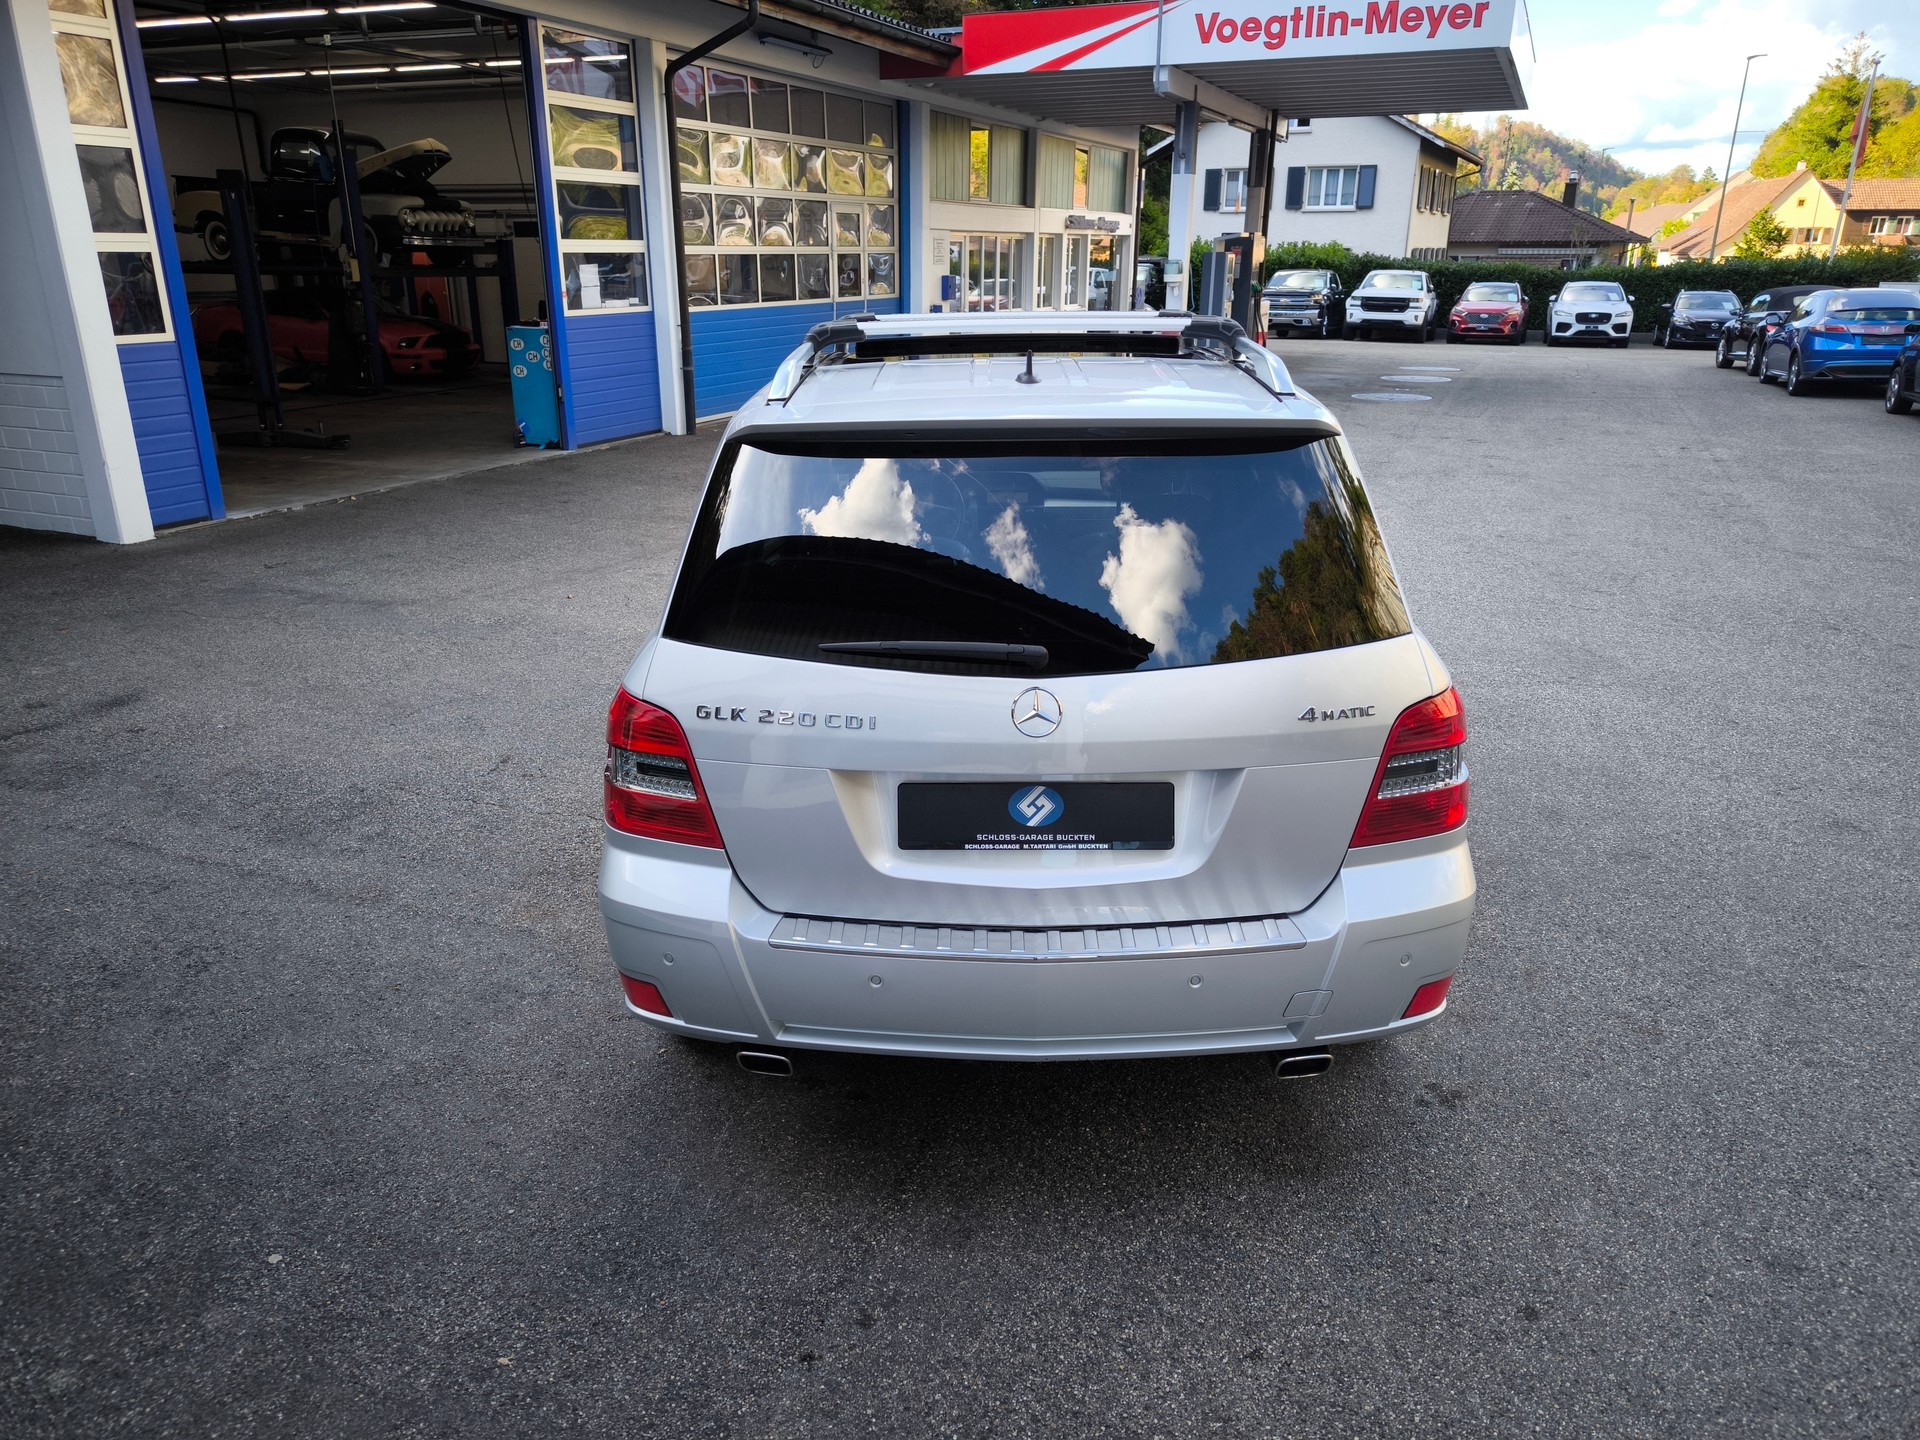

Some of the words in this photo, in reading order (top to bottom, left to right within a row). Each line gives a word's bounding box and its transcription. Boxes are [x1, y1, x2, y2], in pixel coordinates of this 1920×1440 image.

[1195, 0, 1490, 50] Voegtlin-Meyer
[512, 339, 522, 349] CH
[527, 352, 538, 361] CH
[515, 366, 525, 376] CH
[696, 704, 747, 722] GLK
[758, 709, 816, 727] 220
[825, 712, 876, 730] CDI
